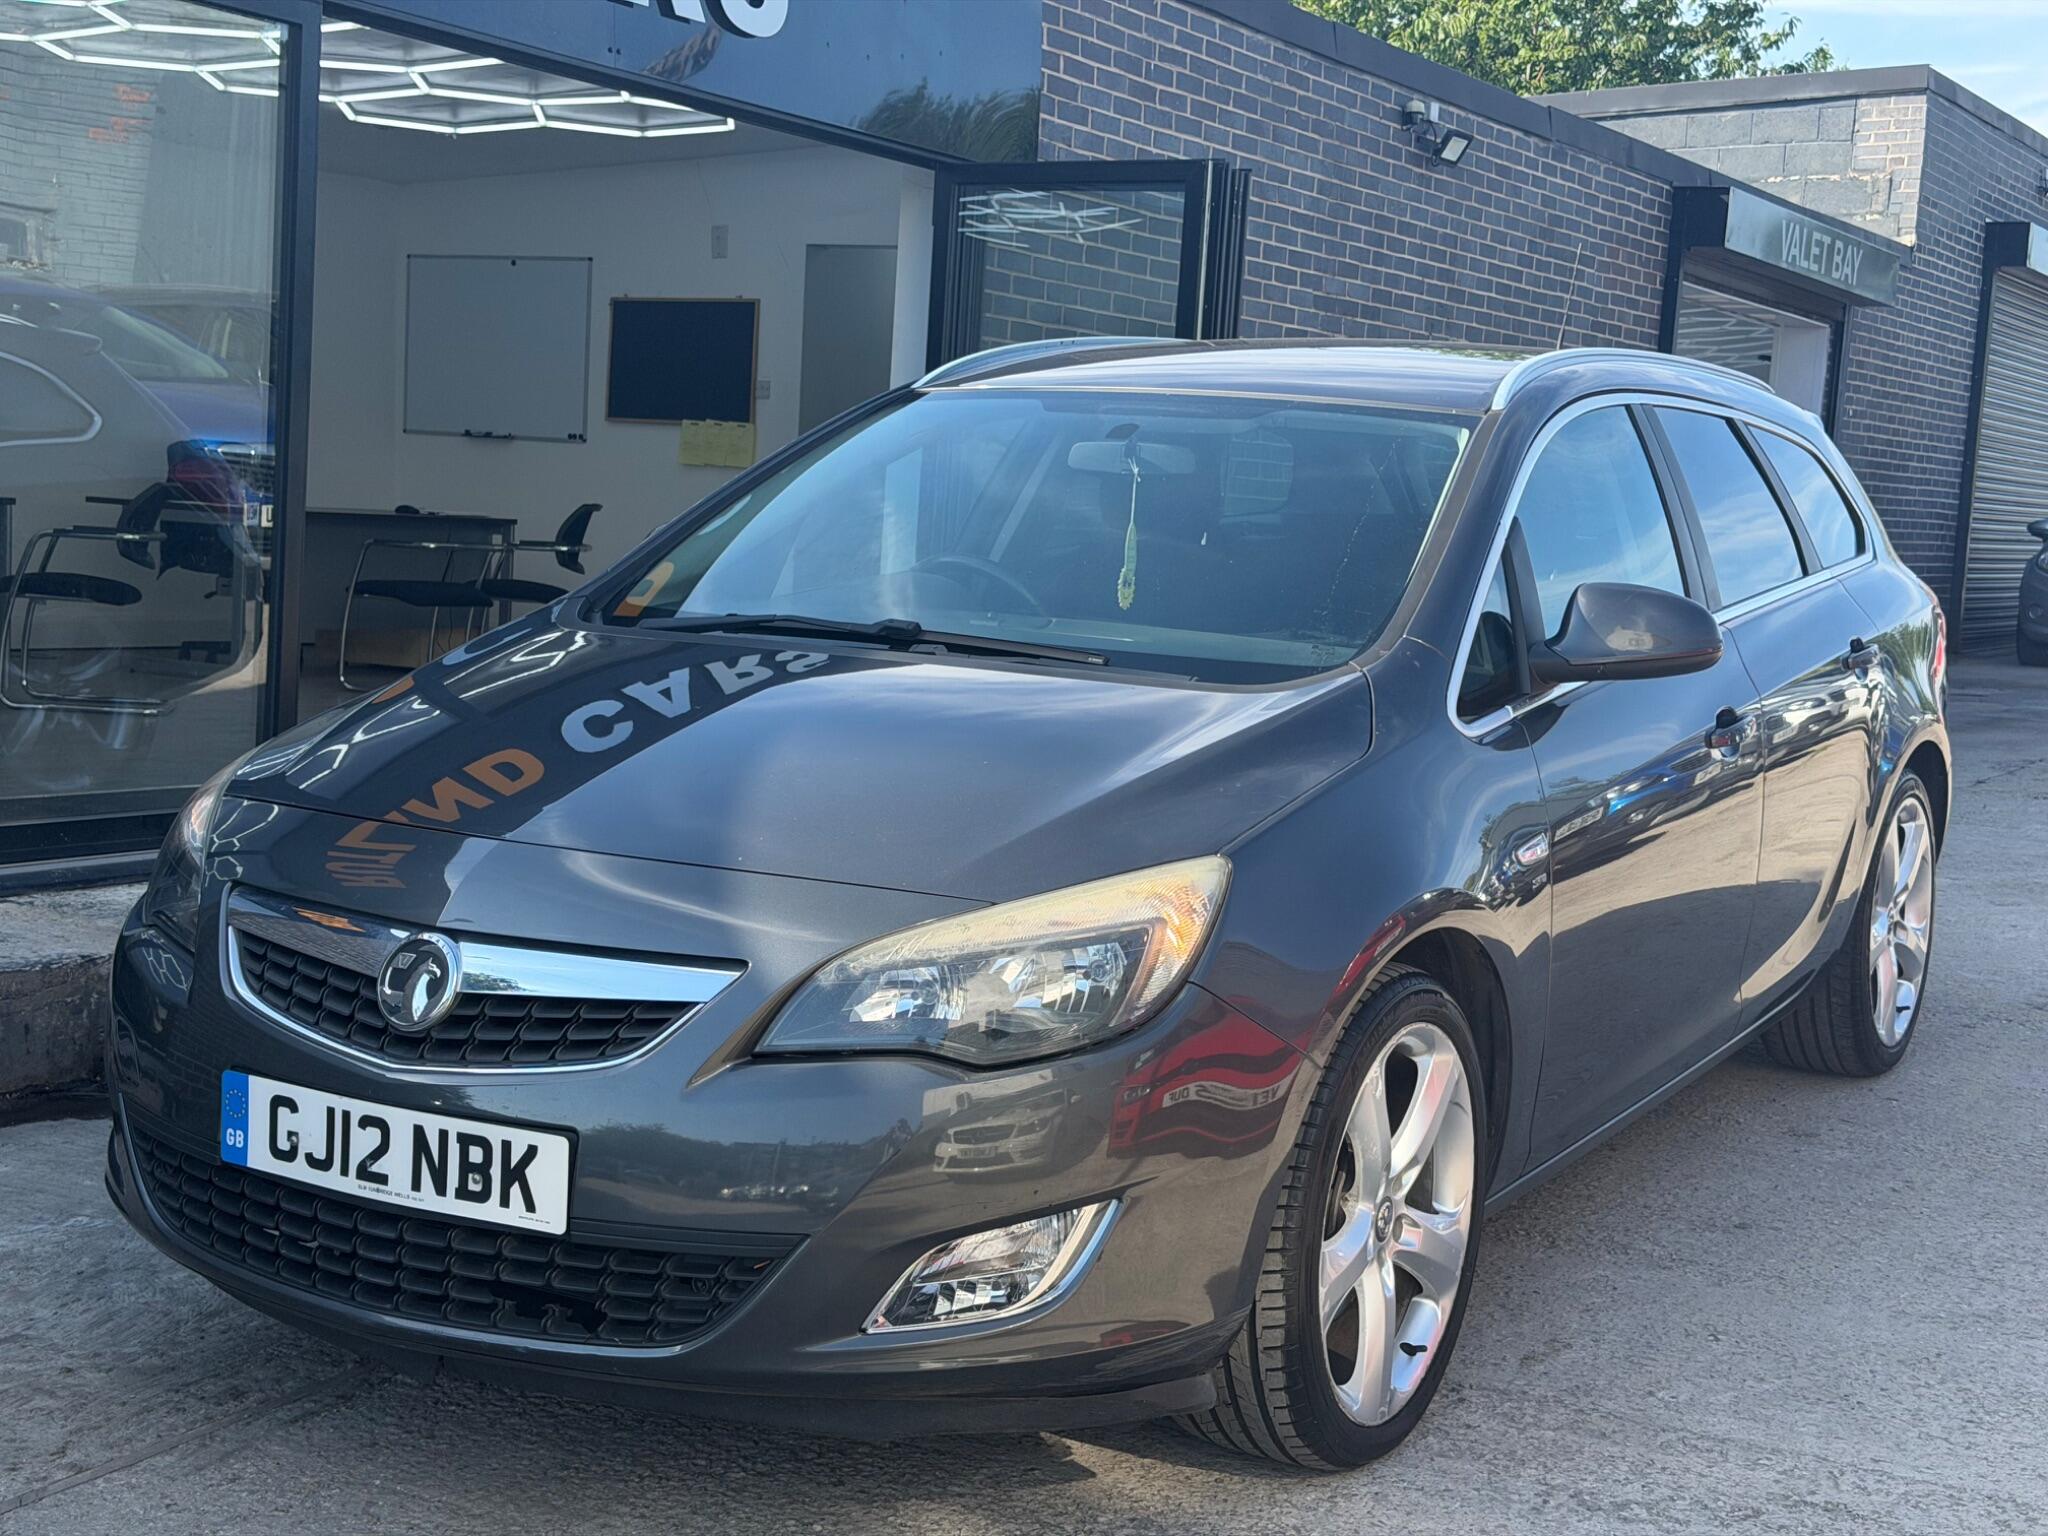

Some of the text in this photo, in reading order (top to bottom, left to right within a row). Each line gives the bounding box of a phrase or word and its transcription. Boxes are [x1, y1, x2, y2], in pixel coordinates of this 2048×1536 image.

[1781, 219, 1863, 285] VALET BAY
[225, 1127, 244, 1149] GB
[268, 1093, 539, 1214] GJ12 NBK
